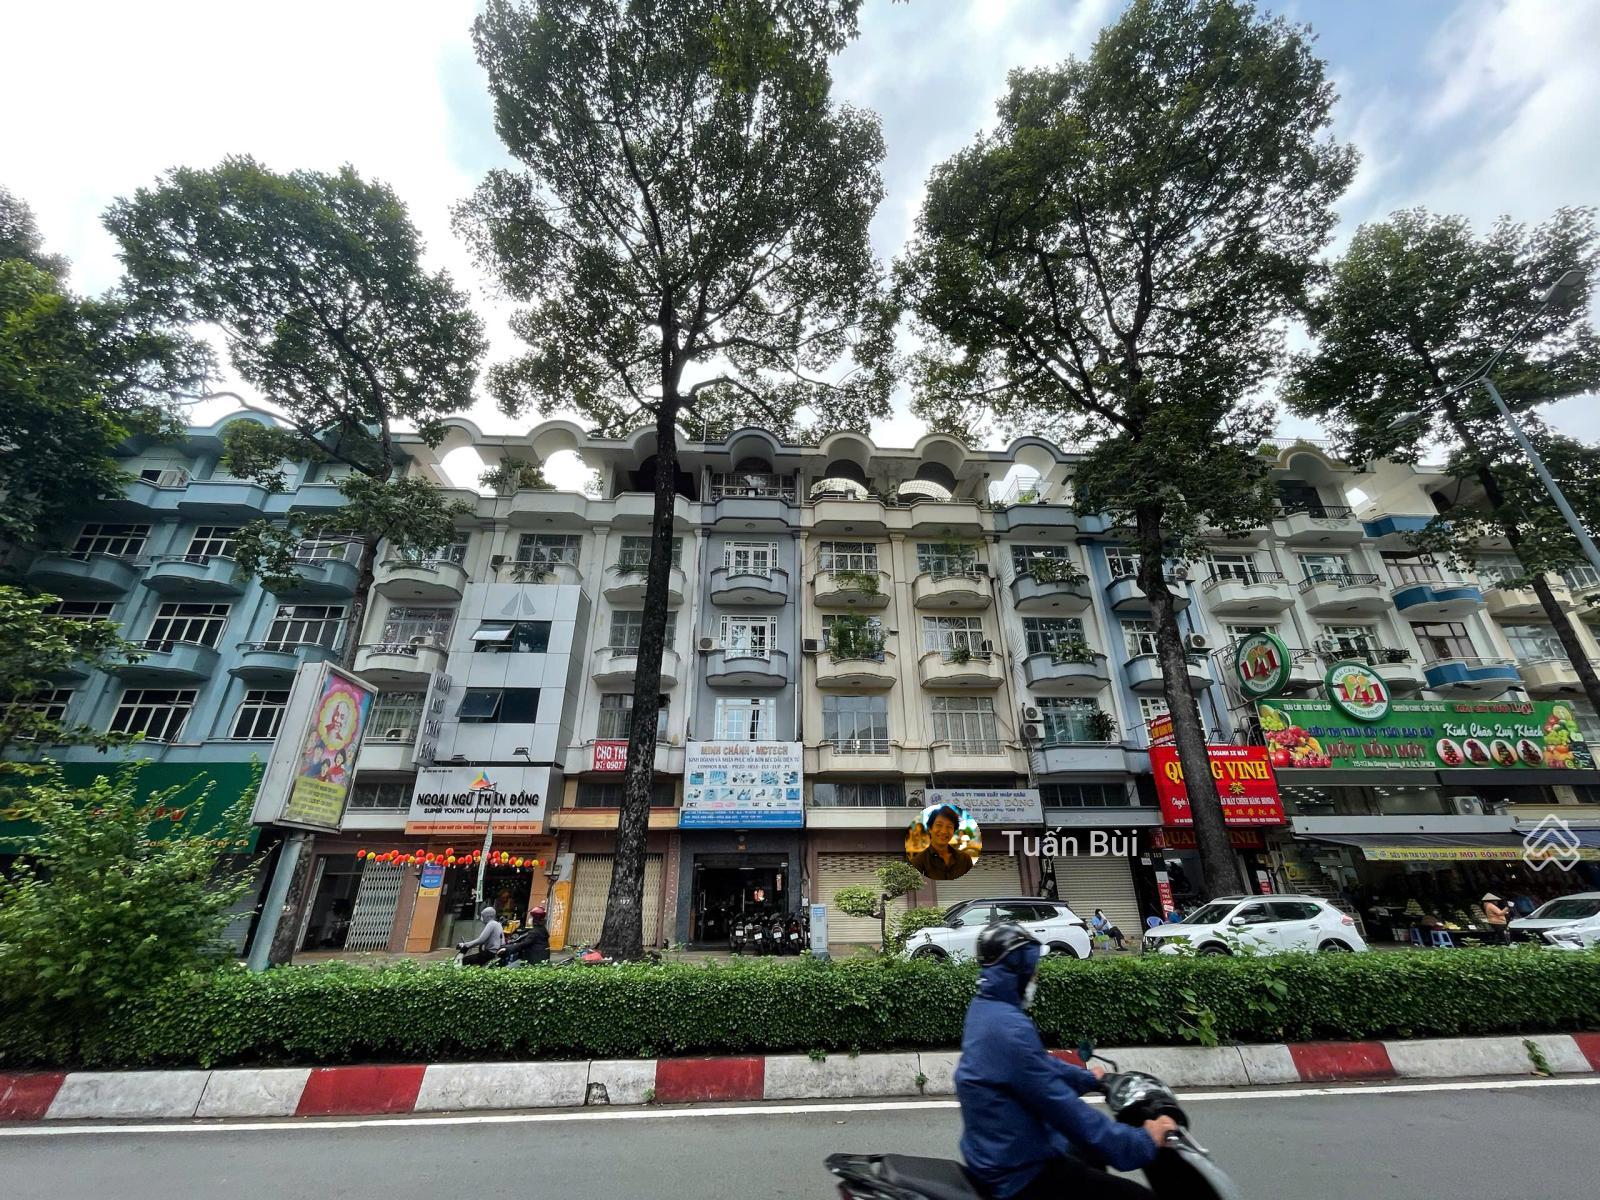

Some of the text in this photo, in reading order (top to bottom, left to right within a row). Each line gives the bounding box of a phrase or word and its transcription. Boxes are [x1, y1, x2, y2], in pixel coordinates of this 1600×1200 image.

[1240, 649, 1280, 680] 141
[1338, 683, 1387, 706] 141
[1443, 723, 1468, 737] Kính
[1470, 722, 1493, 738] Chào
[1514, 724, 1545, 737] Khách
[596, 745, 628, 760] CHO THU
[606, 760, 623, 769] 0907
[1224, 761, 1270, 780] VINH
[417, 793, 449, 807] NGOẠI
[451, 791, 476, 806] NGỮ
[509, 789, 540, 807] ĐỒNG
